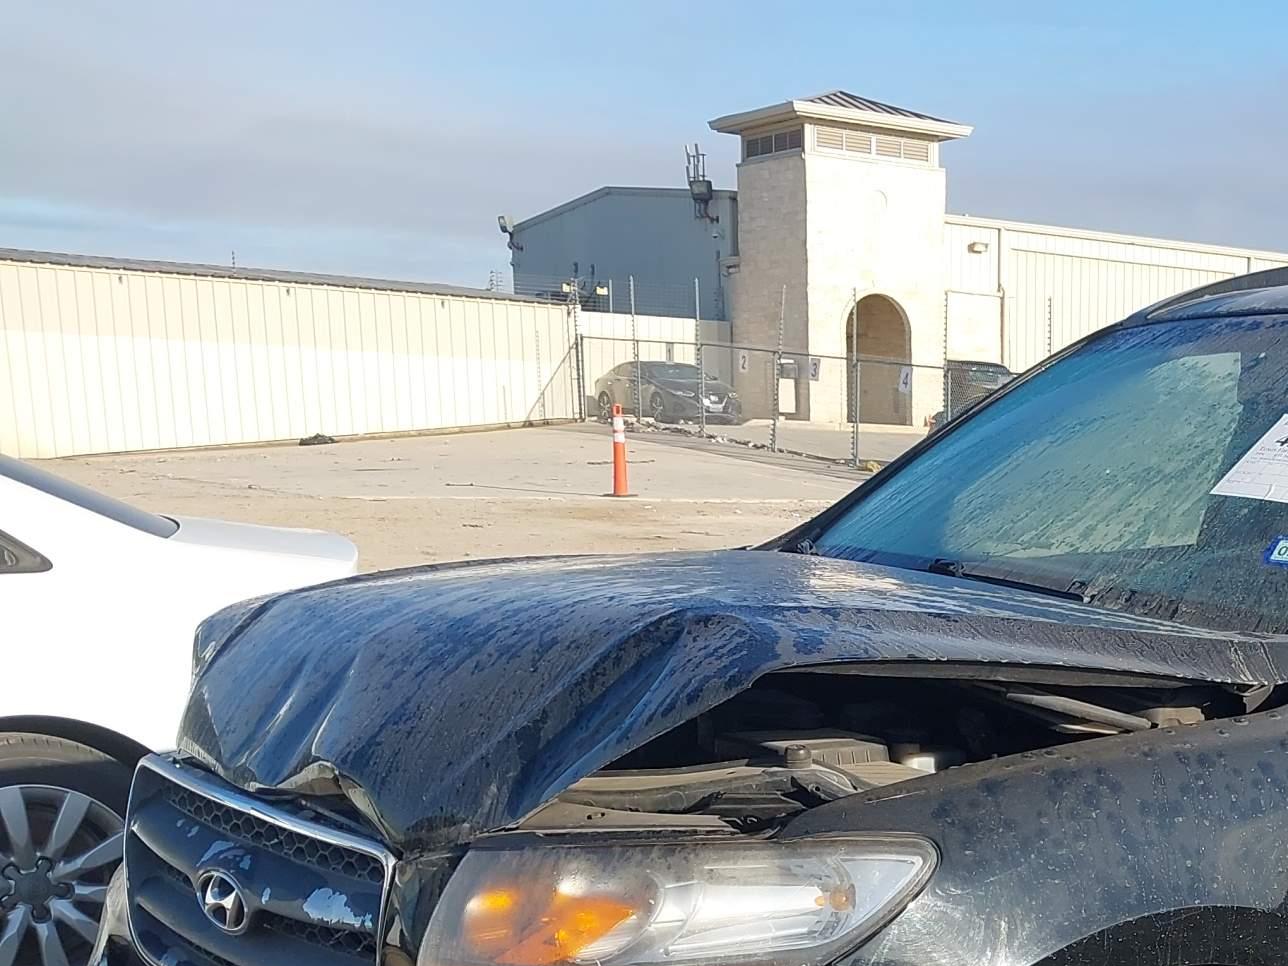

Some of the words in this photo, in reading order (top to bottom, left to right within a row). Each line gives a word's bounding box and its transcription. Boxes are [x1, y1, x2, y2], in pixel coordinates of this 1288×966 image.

[741, 355, 747, 370] 2
[810, 362, 818, 378] 3
[902, 372, 909, 389] 4
